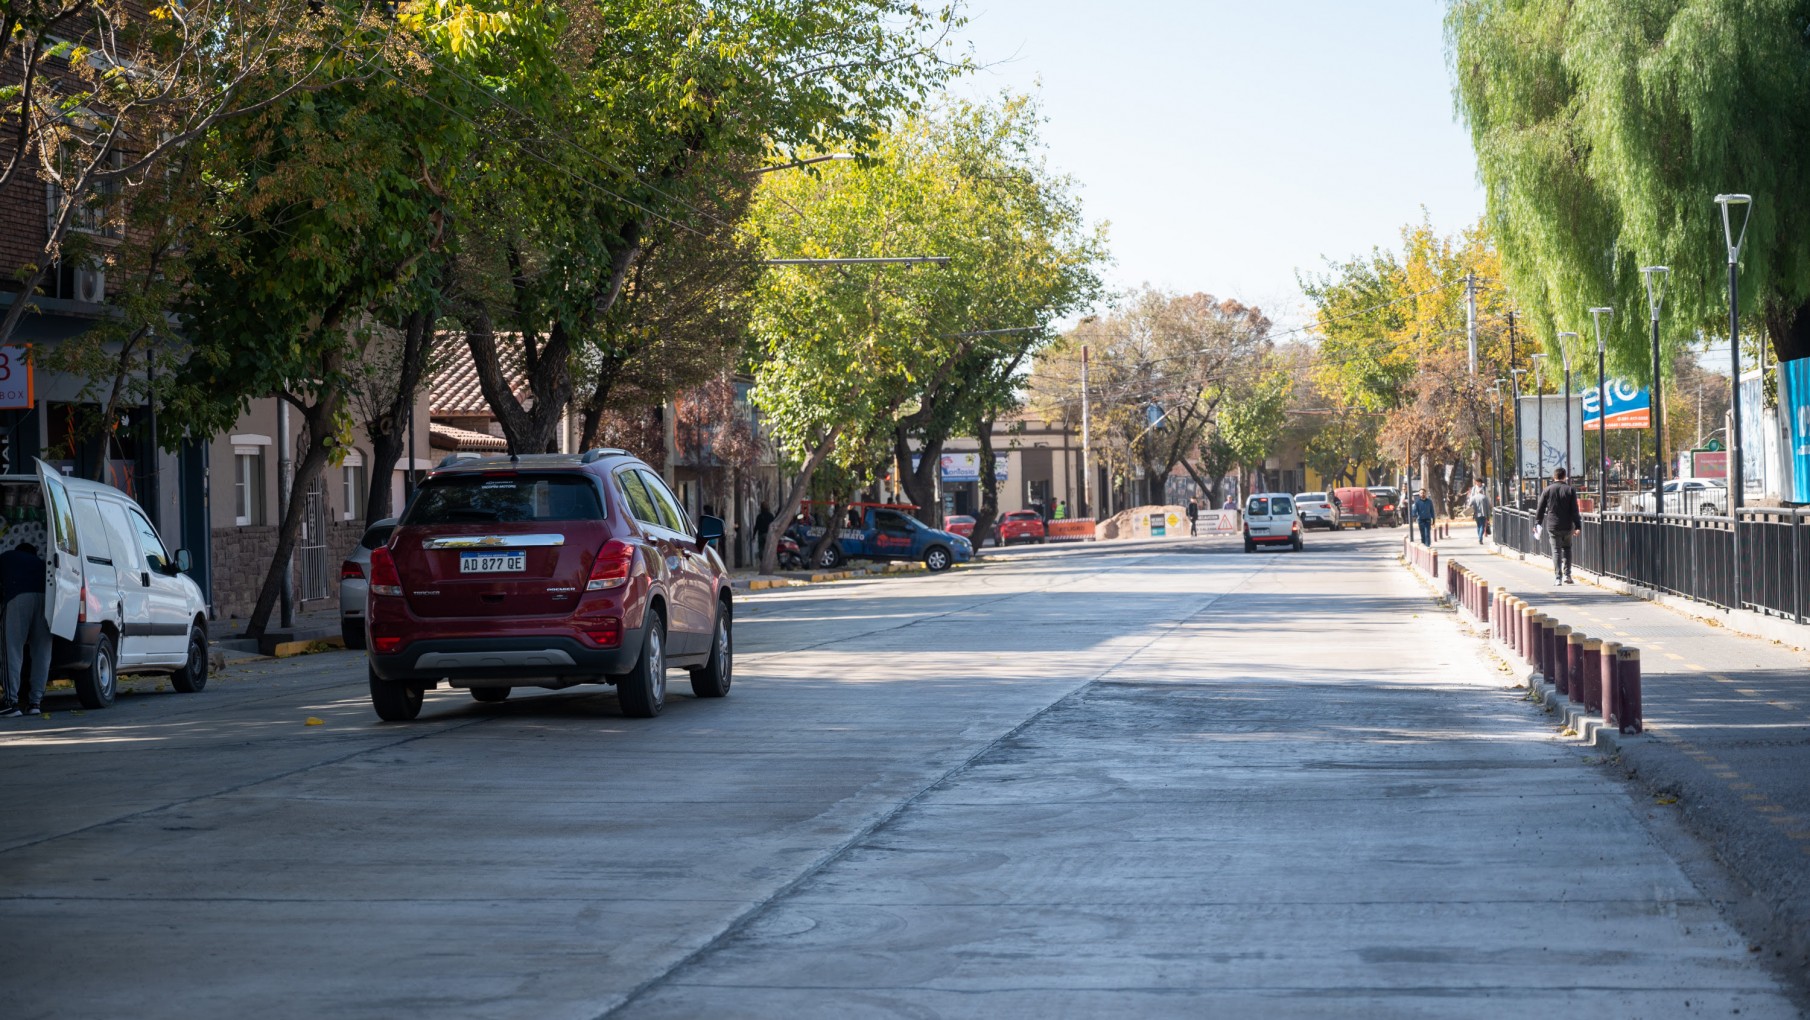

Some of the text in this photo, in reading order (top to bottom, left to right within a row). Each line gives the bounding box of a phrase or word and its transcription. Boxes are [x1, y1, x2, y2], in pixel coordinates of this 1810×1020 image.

[463, 557, 522, 571] AD 877 QE
